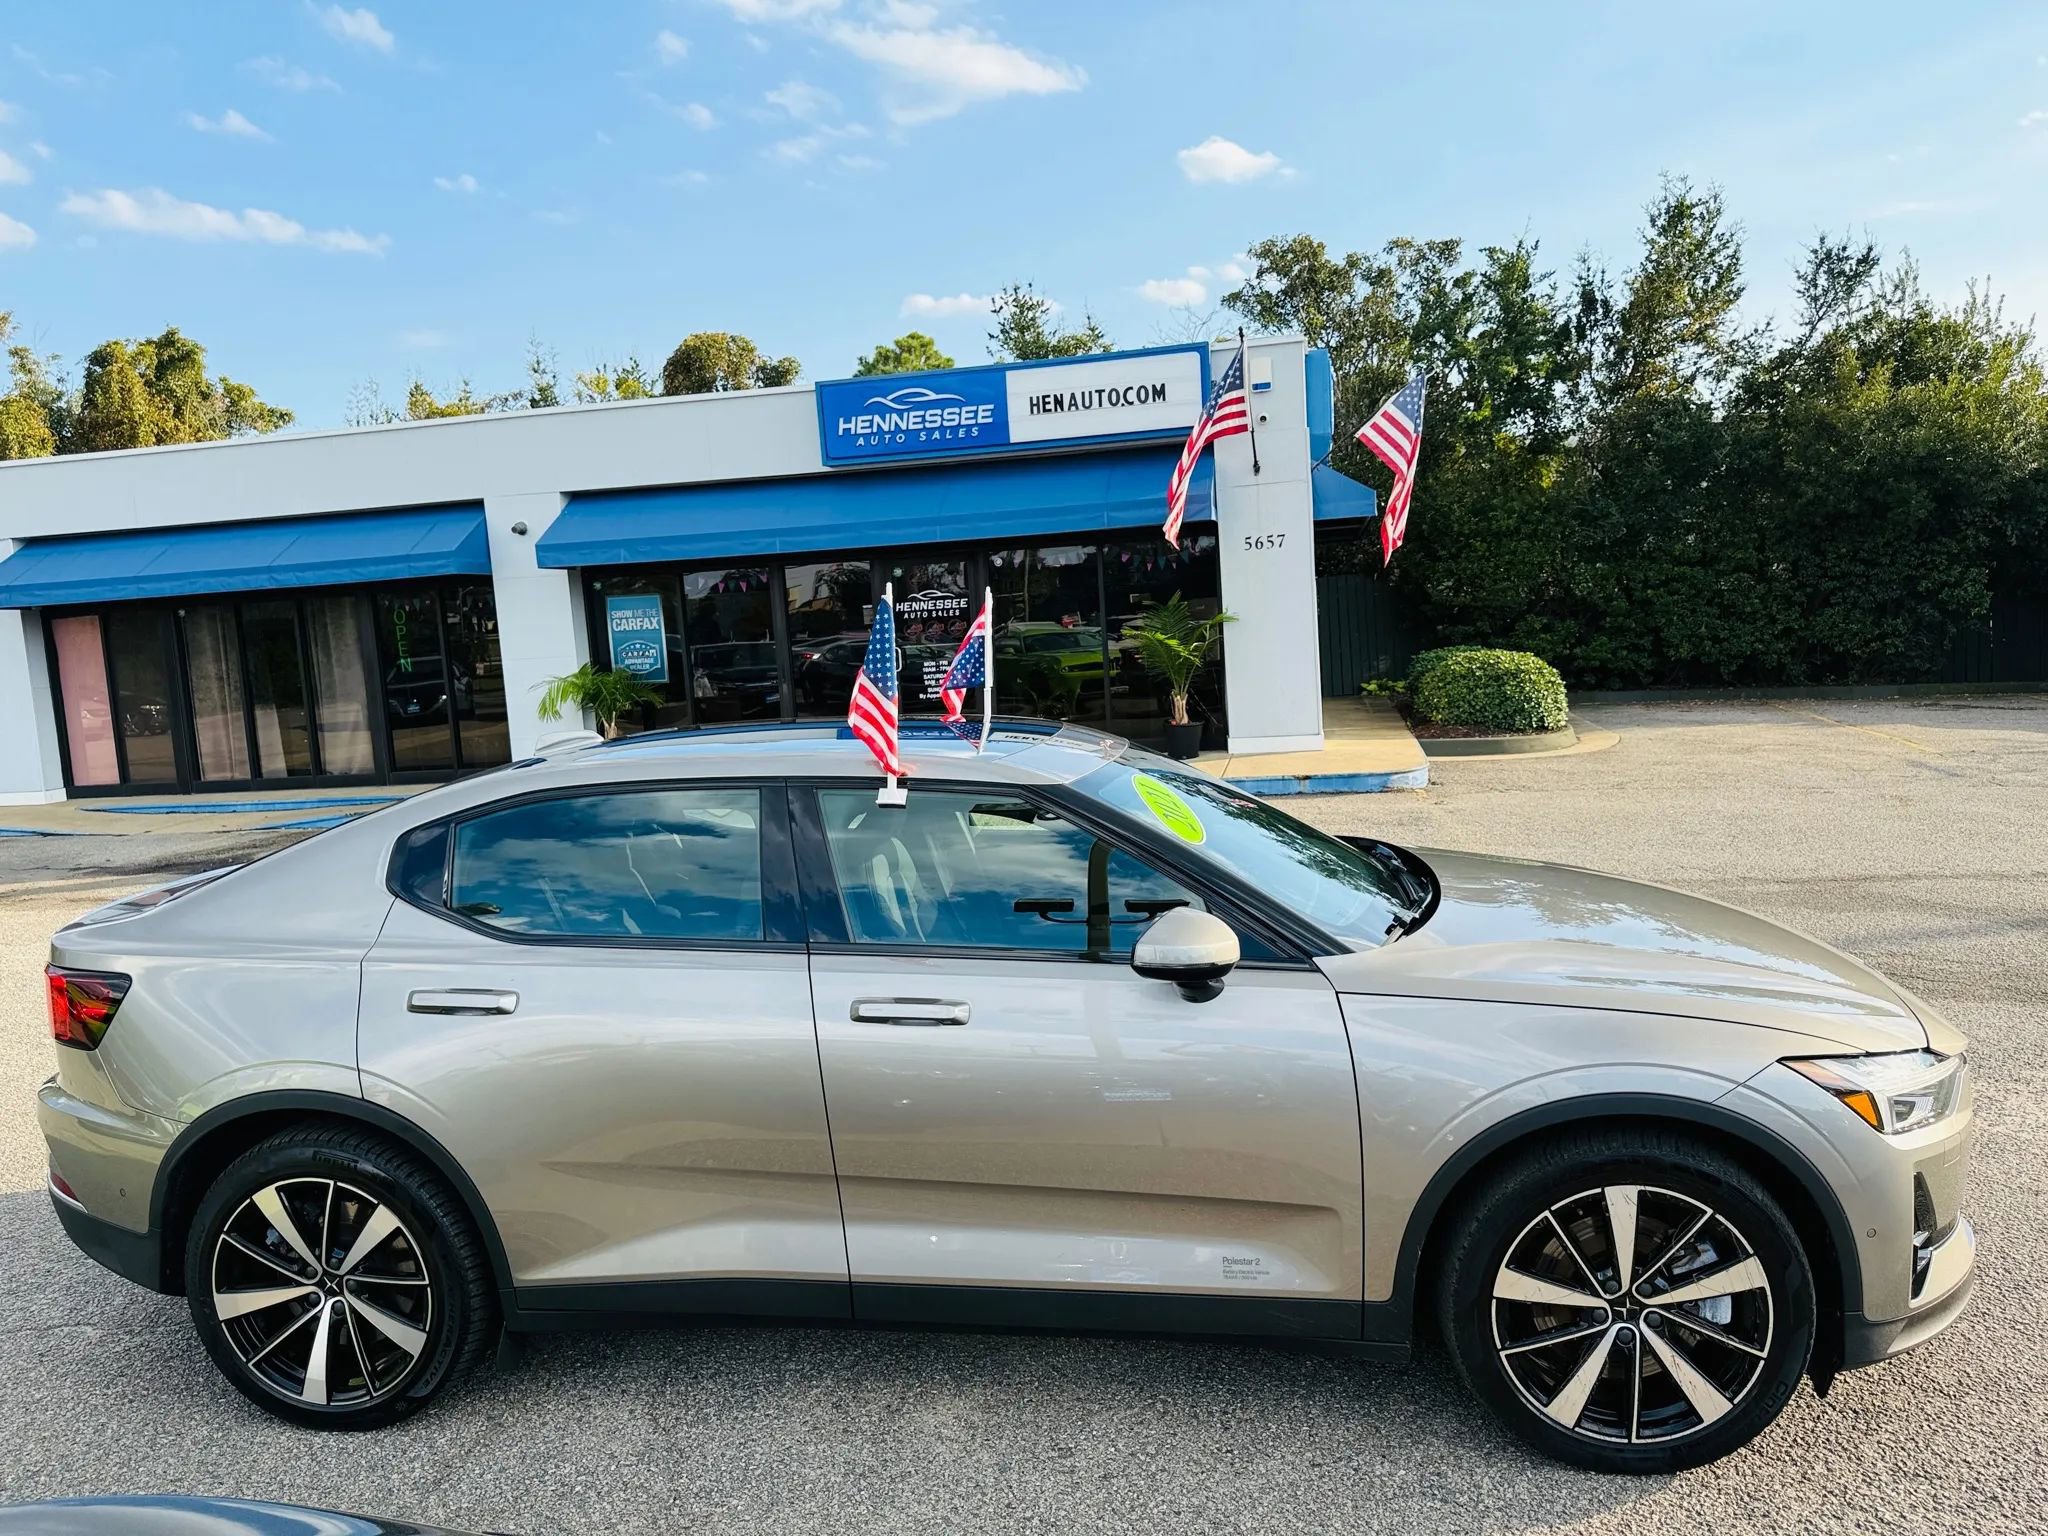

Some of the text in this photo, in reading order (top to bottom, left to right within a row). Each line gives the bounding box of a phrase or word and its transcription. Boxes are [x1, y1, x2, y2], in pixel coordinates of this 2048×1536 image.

[1029, 383, 1166, 415] HENAUTO.COM
[838, 404, 995, 435] HENNESSEE
[856, 427, 979, 446] AUTO SALES
[1244, 534, 1286, 551] 5657
[895, 598, 968, 612] HENNESSEE
[611, 609, 633, 619] SHOW
[904, 609, 960, 619] AUTO SALES
[612, 617, 660, 632] CARFAX
[393, 608, 412, 672] OPEN
[1222, 1256, 1261, 1266] Polestar 2
